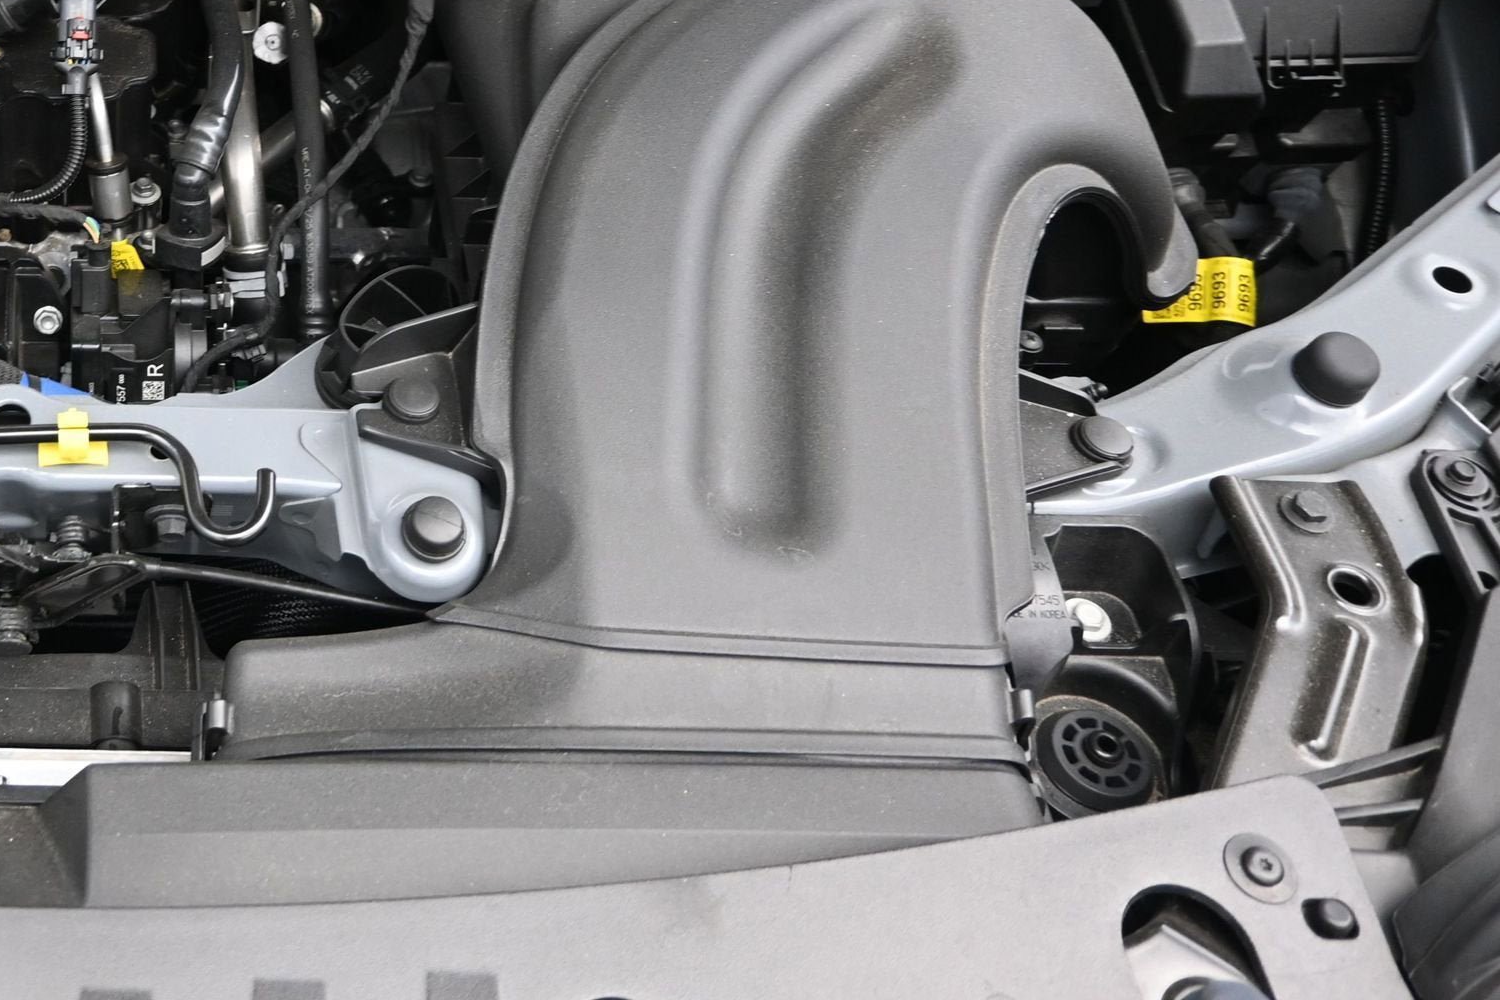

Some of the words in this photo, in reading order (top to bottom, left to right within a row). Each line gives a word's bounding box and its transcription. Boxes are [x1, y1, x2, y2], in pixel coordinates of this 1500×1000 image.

[1212, 271, 1226, 310] 9693
[1237, 274, 1252, 313] 9693
[146, 363, 164, 377] R
[1041, 610, 1067, 619] KOREA
